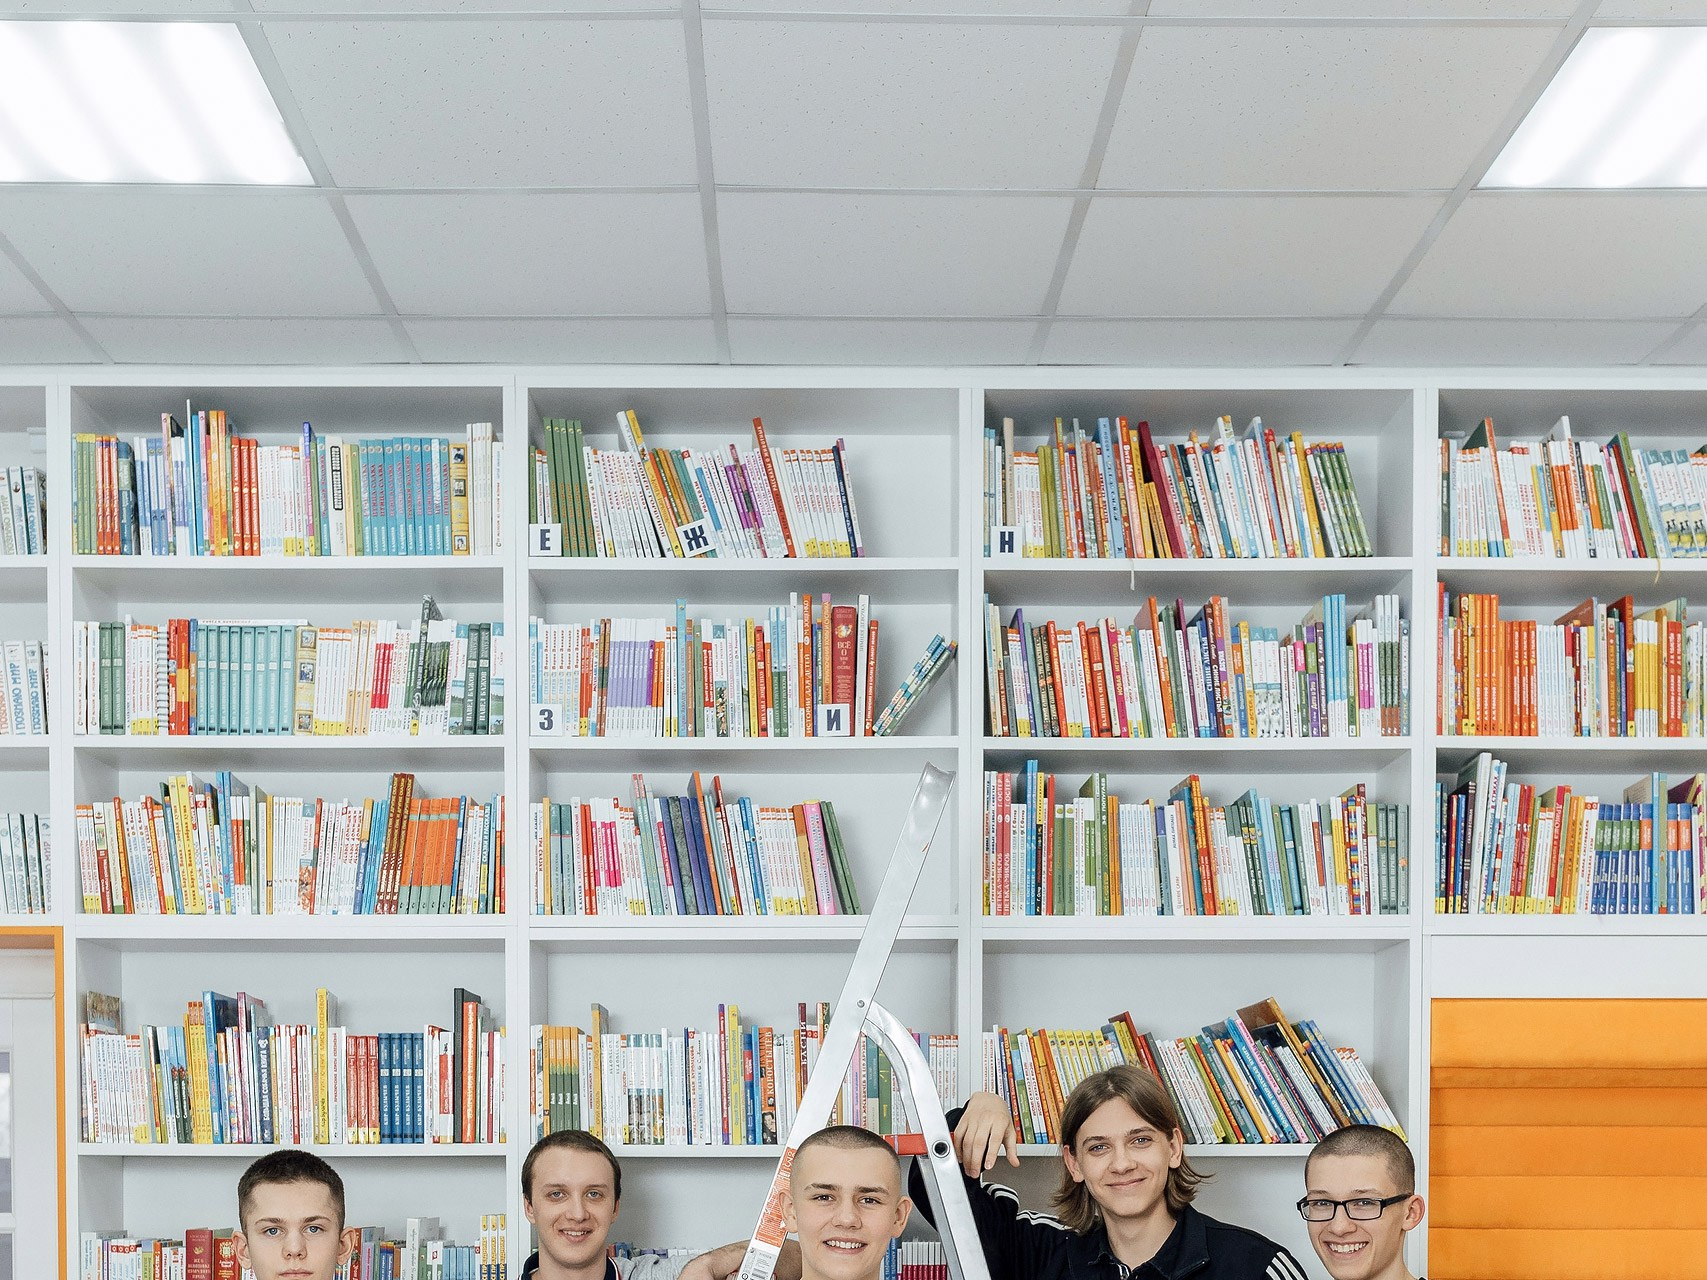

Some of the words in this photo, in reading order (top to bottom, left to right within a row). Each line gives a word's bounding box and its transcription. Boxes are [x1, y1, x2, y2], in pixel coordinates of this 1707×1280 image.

[540, 529, 550, 551] Е
[682, 524, 710, 552] Ж
[1000, 531, 1014, 553] Н
[827, 709, 840, 731] И
